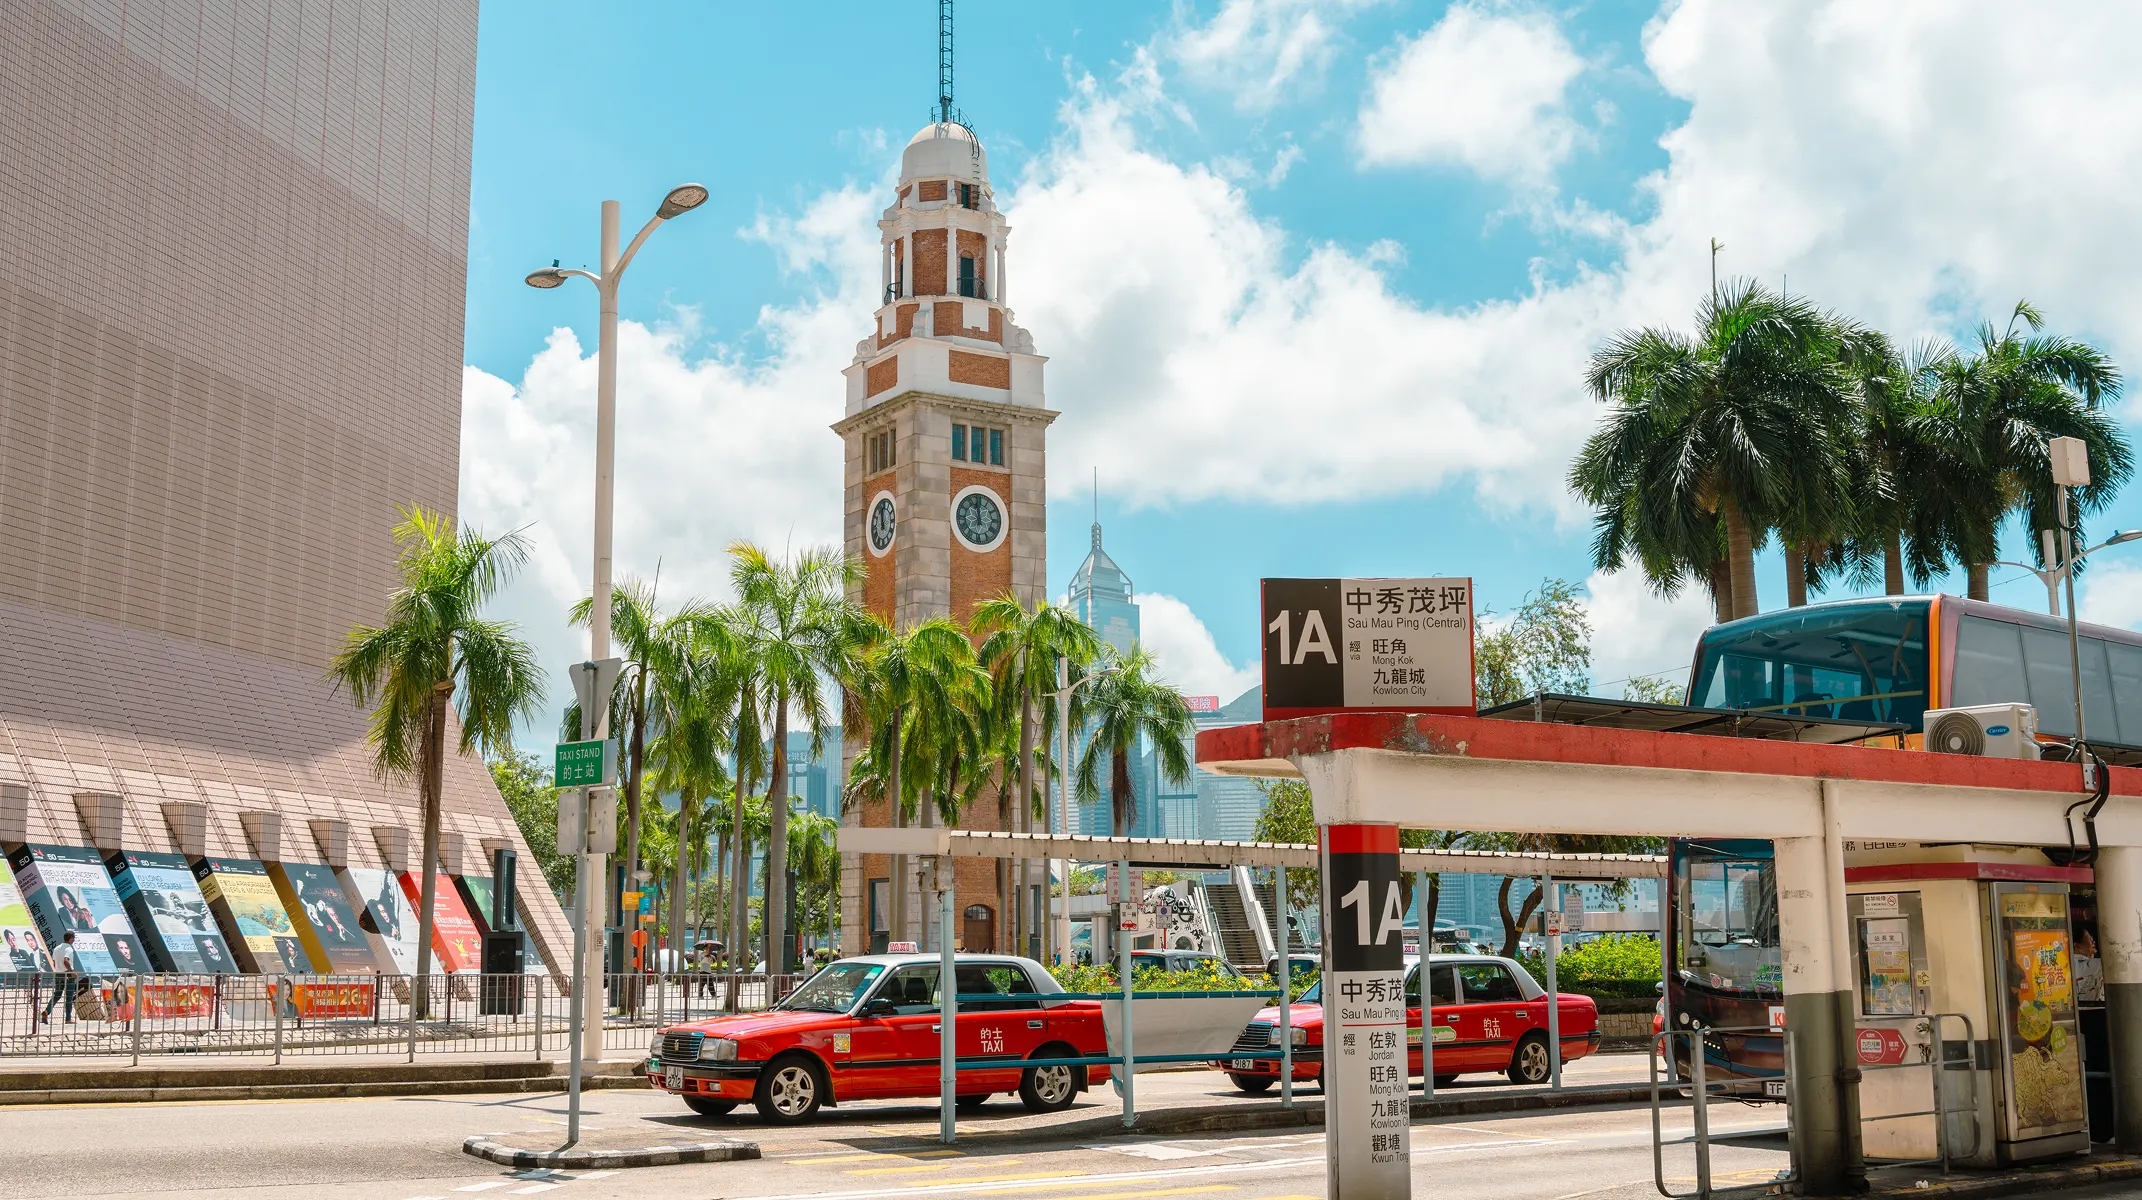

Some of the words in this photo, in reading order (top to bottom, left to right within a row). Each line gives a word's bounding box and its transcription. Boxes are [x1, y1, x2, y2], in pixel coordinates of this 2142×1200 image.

[1346, 586, 1467, 615] 中秀茂坪
[1347, 617, 1368, 629] Sau
[1371, 617, 1393, 629] Mau
[1396, 617, 1419, 630] Ping
[1422, 616, 1466, 630] (Central)
[1269, 610, 1338, 665] 1A
[1349, 641, 1361, 653] 經
[1372, 638, 1407, 655] 旺角
[1349, 653, 1361, 661] via
[1372, 656, 1396, 666] Mong
[1398, 656, 1414, 665] Kok
[1373, 668, 1425, 685] 九龍城
[1373, 686, 1408, 695] Kowloon
[1410, 686, 1427, 696] City
[1987, 727, 2007, 735] Carrier
[559, 751, 575, 761] TAXI
[575, 747, 600, 760] STAND
[563, 762, 595, 780] 的士站
[889, 942, 910, 951] TAXI
[340, 988, 362, 1006] 26
[1341, 978, 1406, 1004] 中秀茂
[1342, 1007, 1362, 1020] Sau
[1364, 1007, 1384, 1019] Mau
[1385, 1007, 1400, 1023] Ping
[1484, 1018, 1500, 1028] 的士
[981, 1027, 1003, 1040] 的士
[1343, 1033, 1356, 1047] 經
[1369, 1031, 1398, 1049] 佐敦
[1484, 1028, 1501, 1039] TAXI
[981, 1040, 1003, 1053] TAXI
[1344, 1047, 1356, 1056] via
[1369, 1050, 1395, 1061] Jordan
[1235, 1059, 1251, 1069] 9187
[1370, 1065, 1399, 1083] 旺角
[1370, 1084, 1392, 1097] Mong
[1393, 1084, 1405, 1095] Kok
[1769, 1083, 1783, 1095] TF
[1371, 1118, 1401, 1129] Kowloon
[1372, 1134, 1401, 1152] 觀塘
[1372, 1153, 1394, 1164] Kwun
